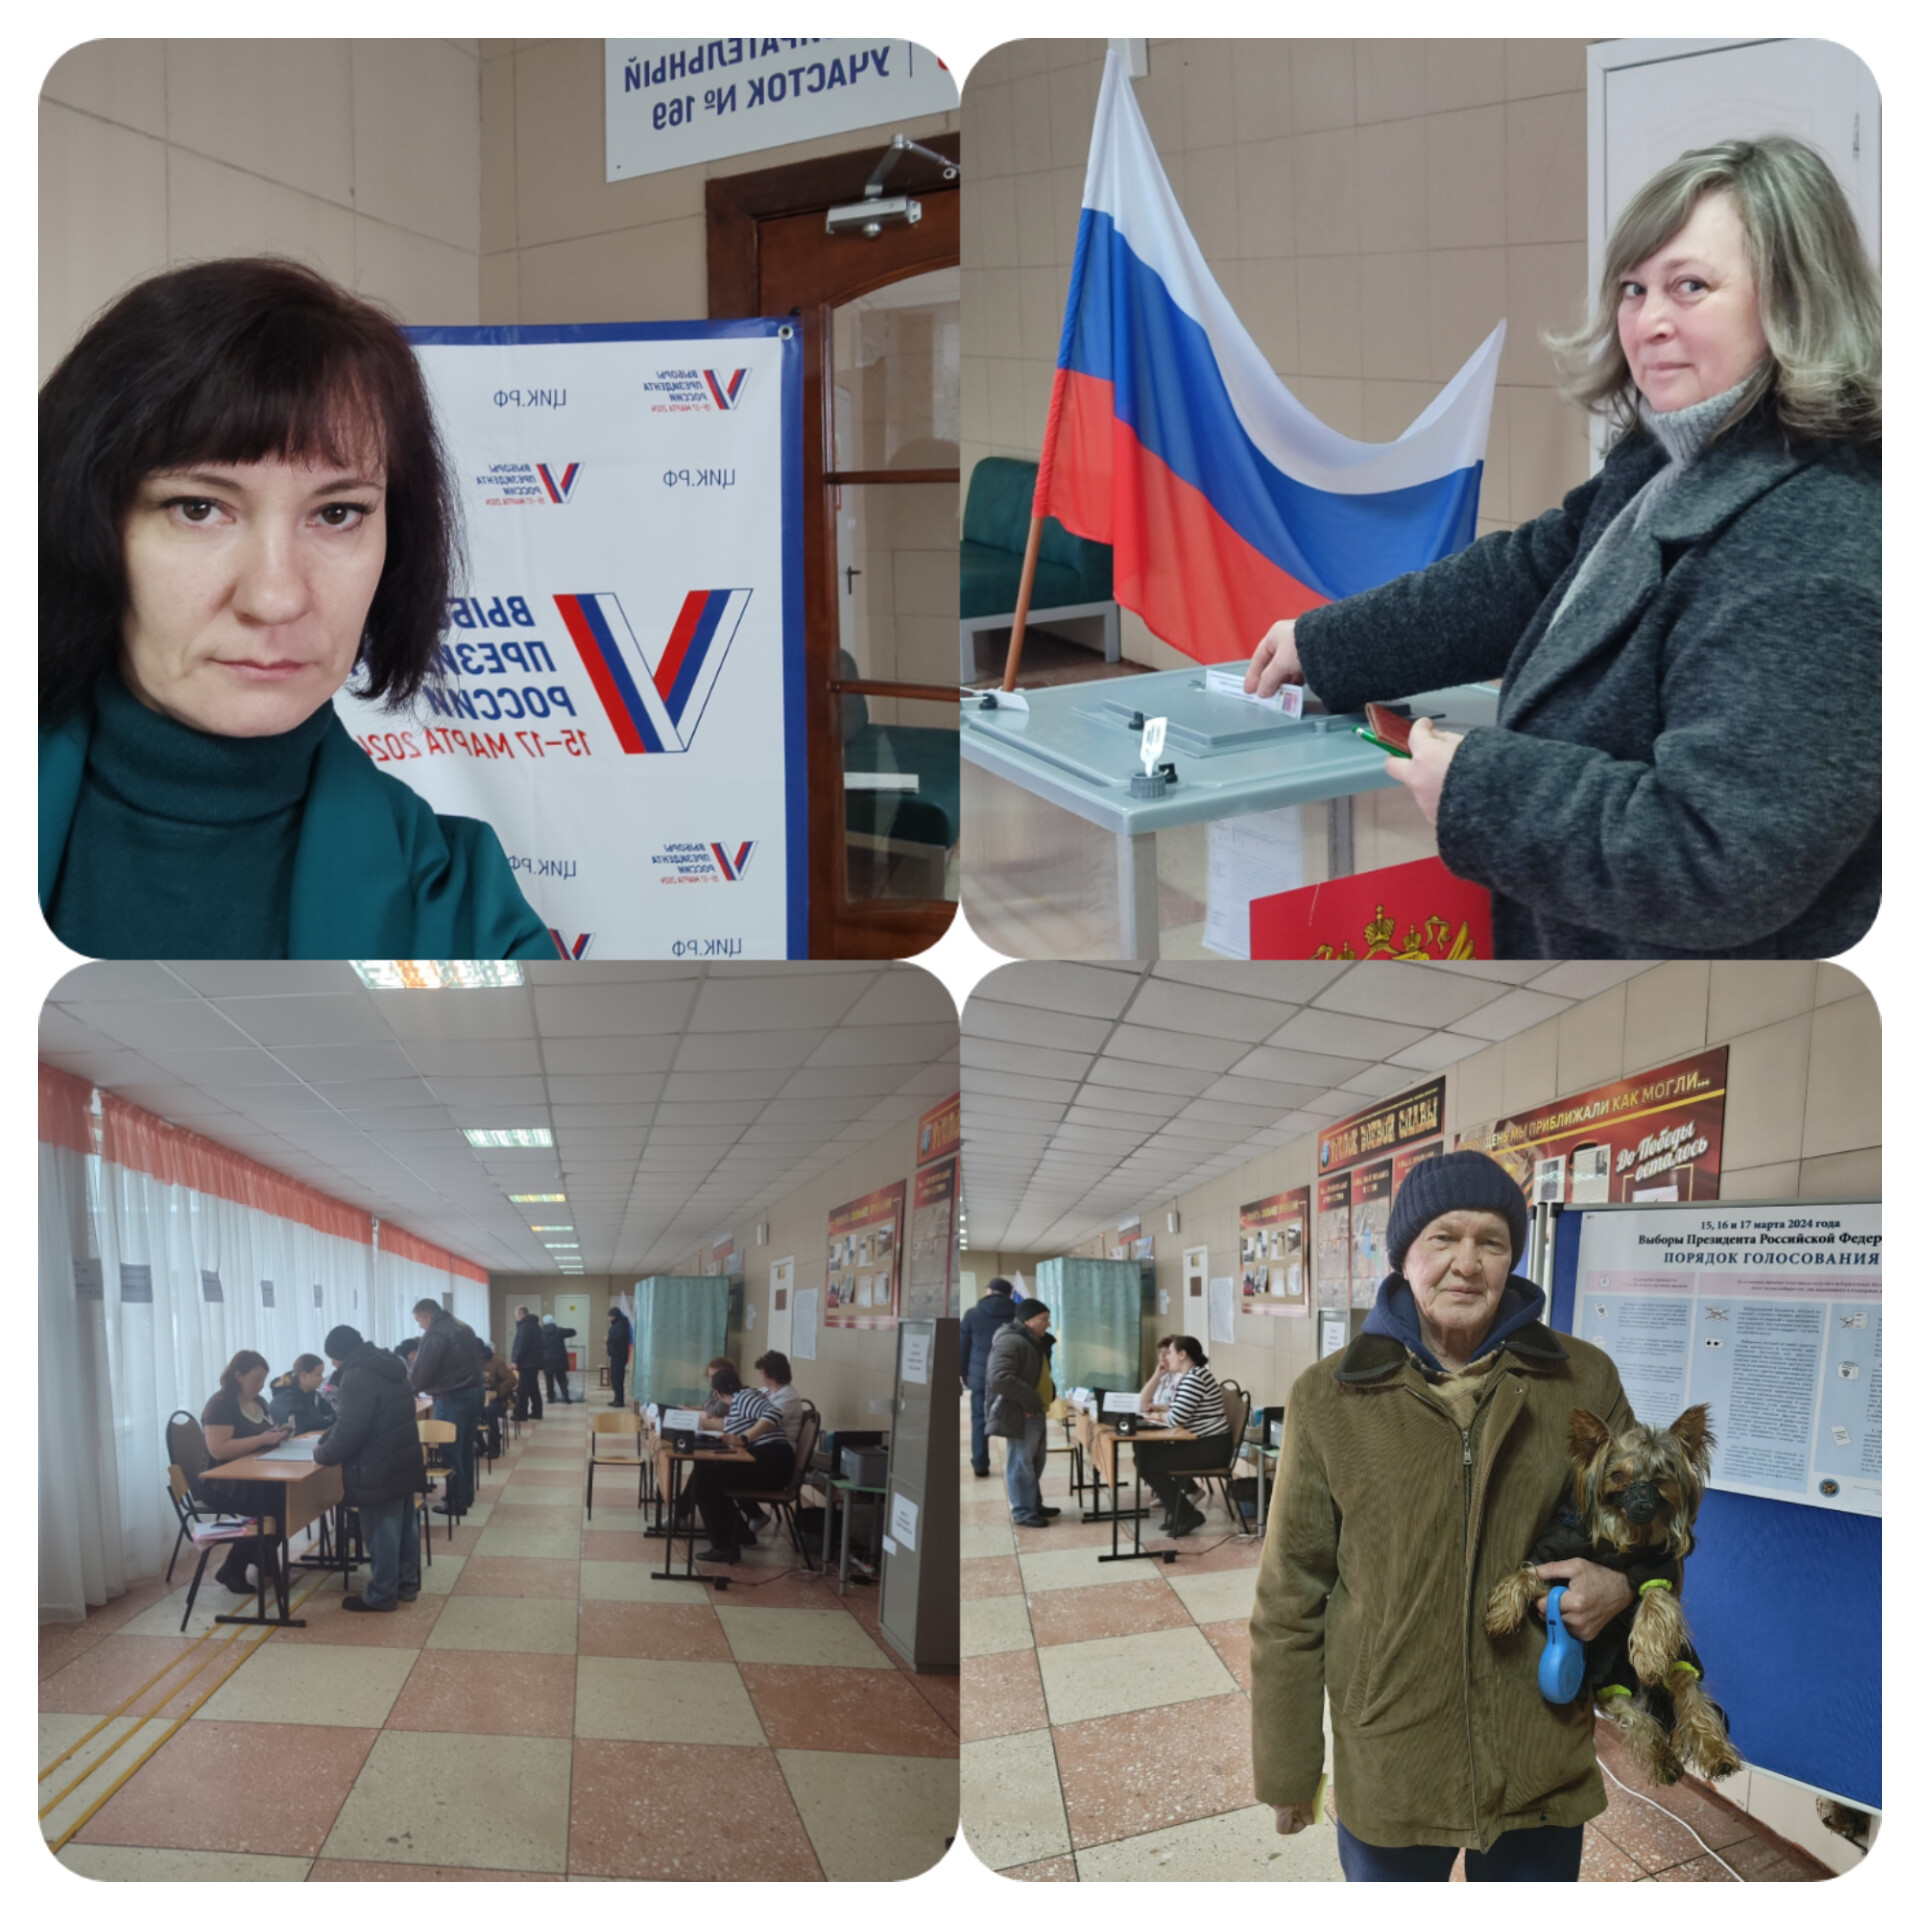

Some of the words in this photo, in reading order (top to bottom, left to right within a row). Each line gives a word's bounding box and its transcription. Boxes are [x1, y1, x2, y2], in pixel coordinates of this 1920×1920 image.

[1398, 1096, 1439, 1139] СЛАВЫ
[1485, 1131, 1509, 1150] ДЕНЬ
[1509, 1125, 1527, 1141] МЫ
[1529, 1099, 1610, 1136] ПРИБЛИЖАЛИ
[1612, 1090, 1639, 1112] КАК
[1615, 1148, 1637, 1173] До
[1637, 1120, 1697, 1162] Победы
[1634, 1136, 1709, 1182] осталось
[1638, 1234, 1684, 1247] Выборы
[1686, 1234, 1757, 1247] Президента
[1760, 1233, 1835, 1245] Российской
[1701, 1221, 1715, 1231] 15,
[1717, 1220, 1728, 1229] 16
[1740, 1220, 1752, 1229] 17
[1754, 1221, 1785, 1232] марта
[1787, 1219, 1813, 1229] 2024
[1815, 1220, 1841, 1230] года
[1663, 1252, 1738, 1266] ПОРЯДОК
[1743, 1252, 1880, 1265] ГОЛОСОВАНИЯ
